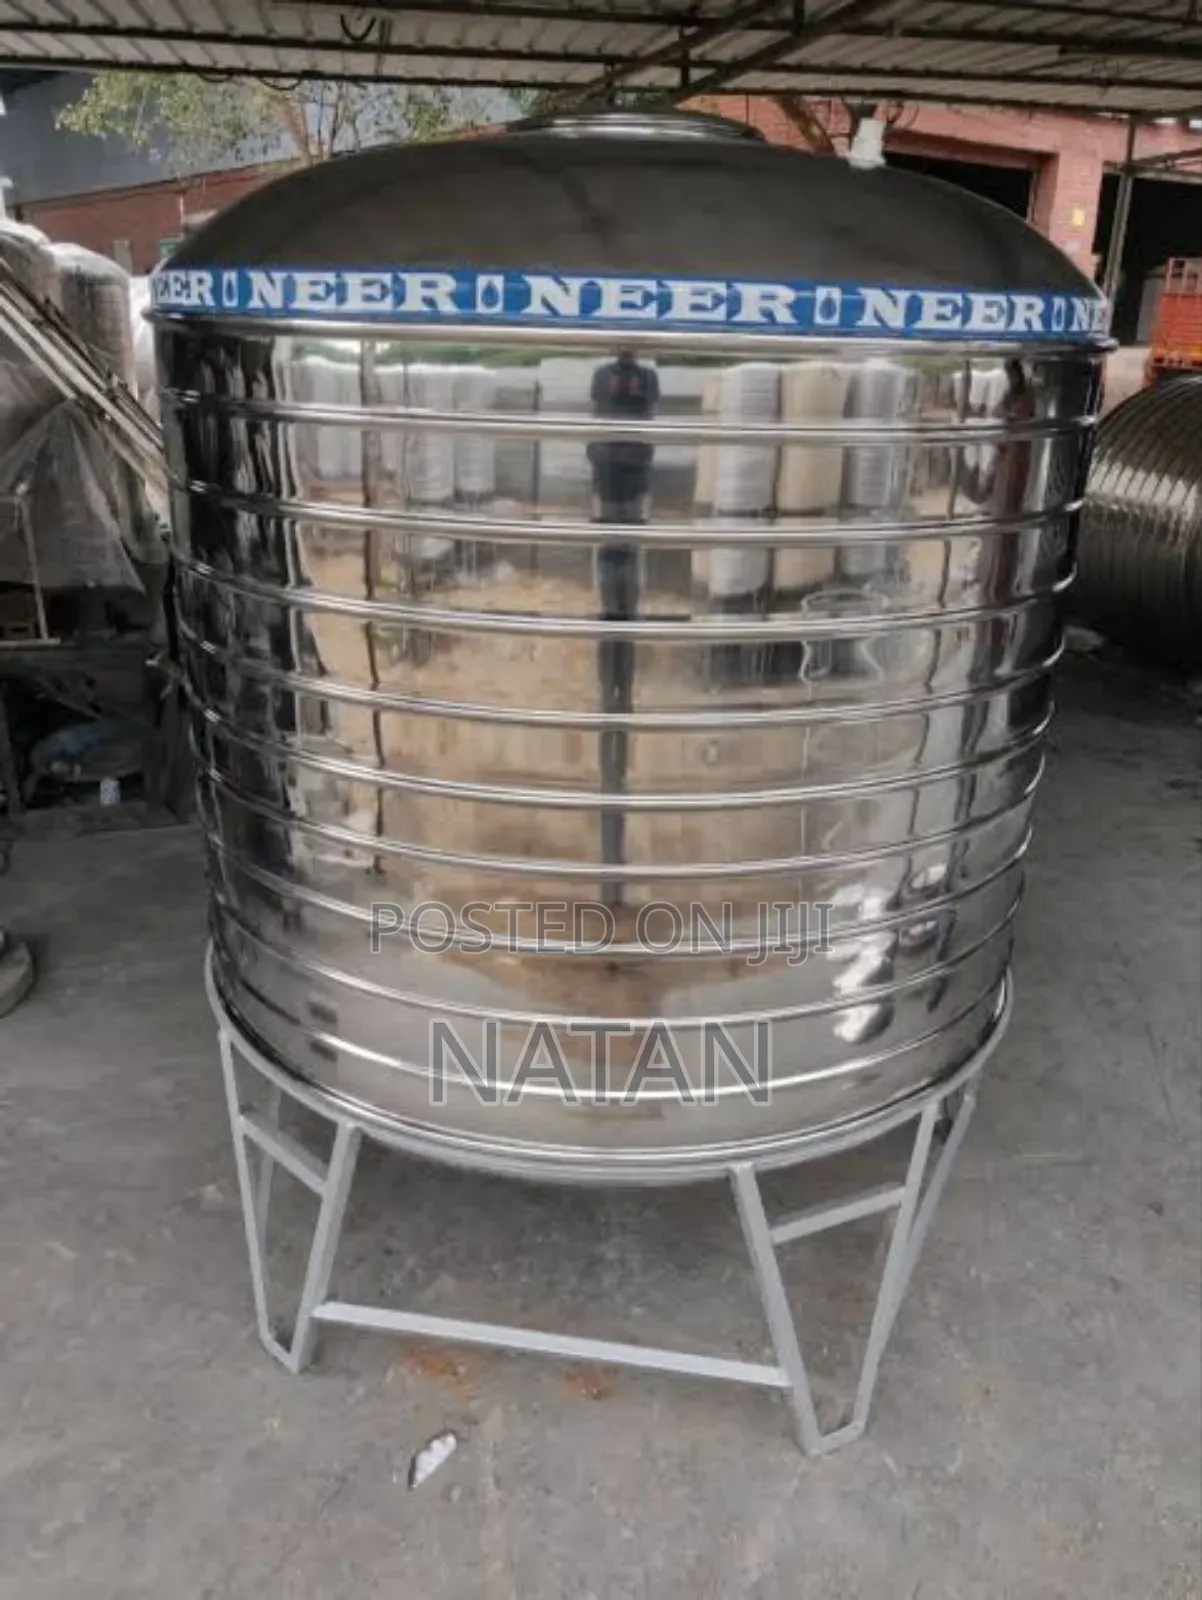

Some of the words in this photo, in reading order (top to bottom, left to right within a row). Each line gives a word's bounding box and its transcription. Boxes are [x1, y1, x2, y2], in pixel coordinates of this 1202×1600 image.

[247, 271, 457, 313] NEER
[522, 275, 797, 324] NEER
[856, 287, 1045, 332] NEER
